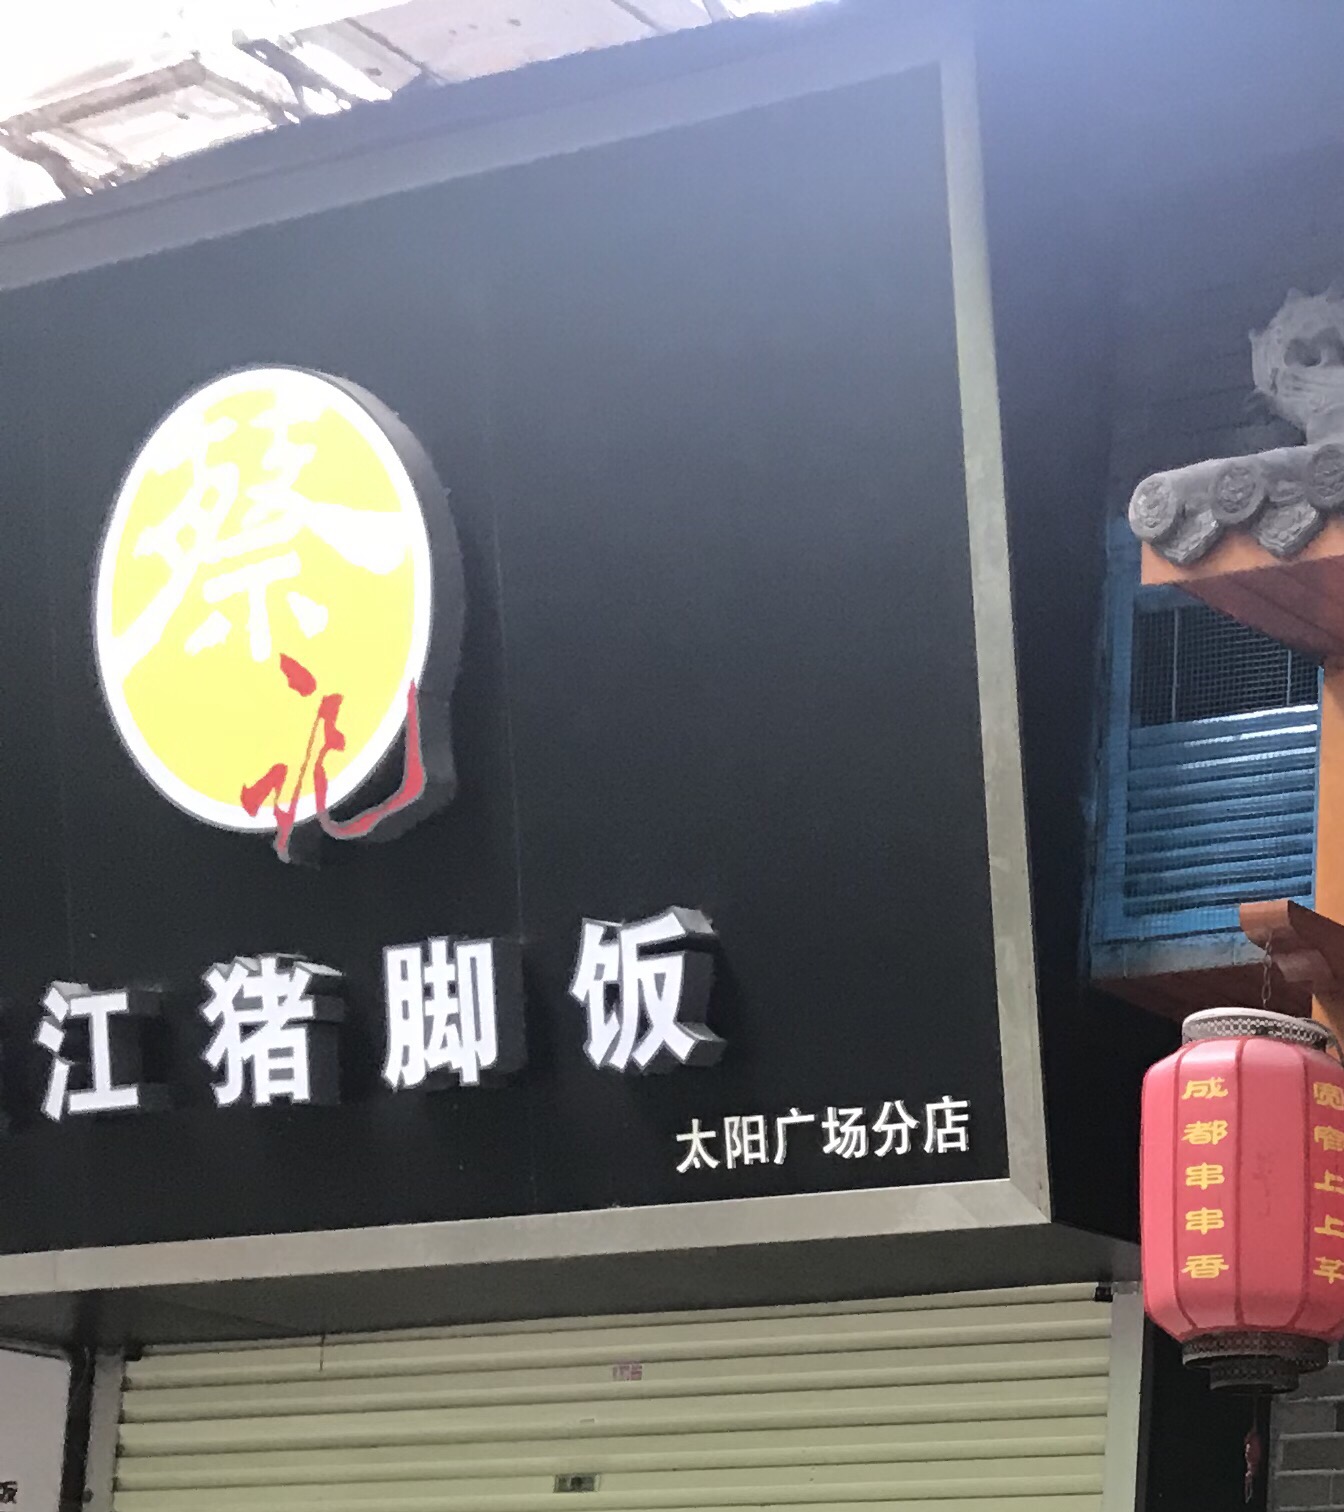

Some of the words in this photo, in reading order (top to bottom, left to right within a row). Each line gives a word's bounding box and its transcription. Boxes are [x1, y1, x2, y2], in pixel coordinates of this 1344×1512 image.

[34, 911, 716, 1121] 江猪脚饭
[676, 1096, 970, 1173] 太阳广场分店
[1181, 1076, 1229, 1279] 成都串串香
